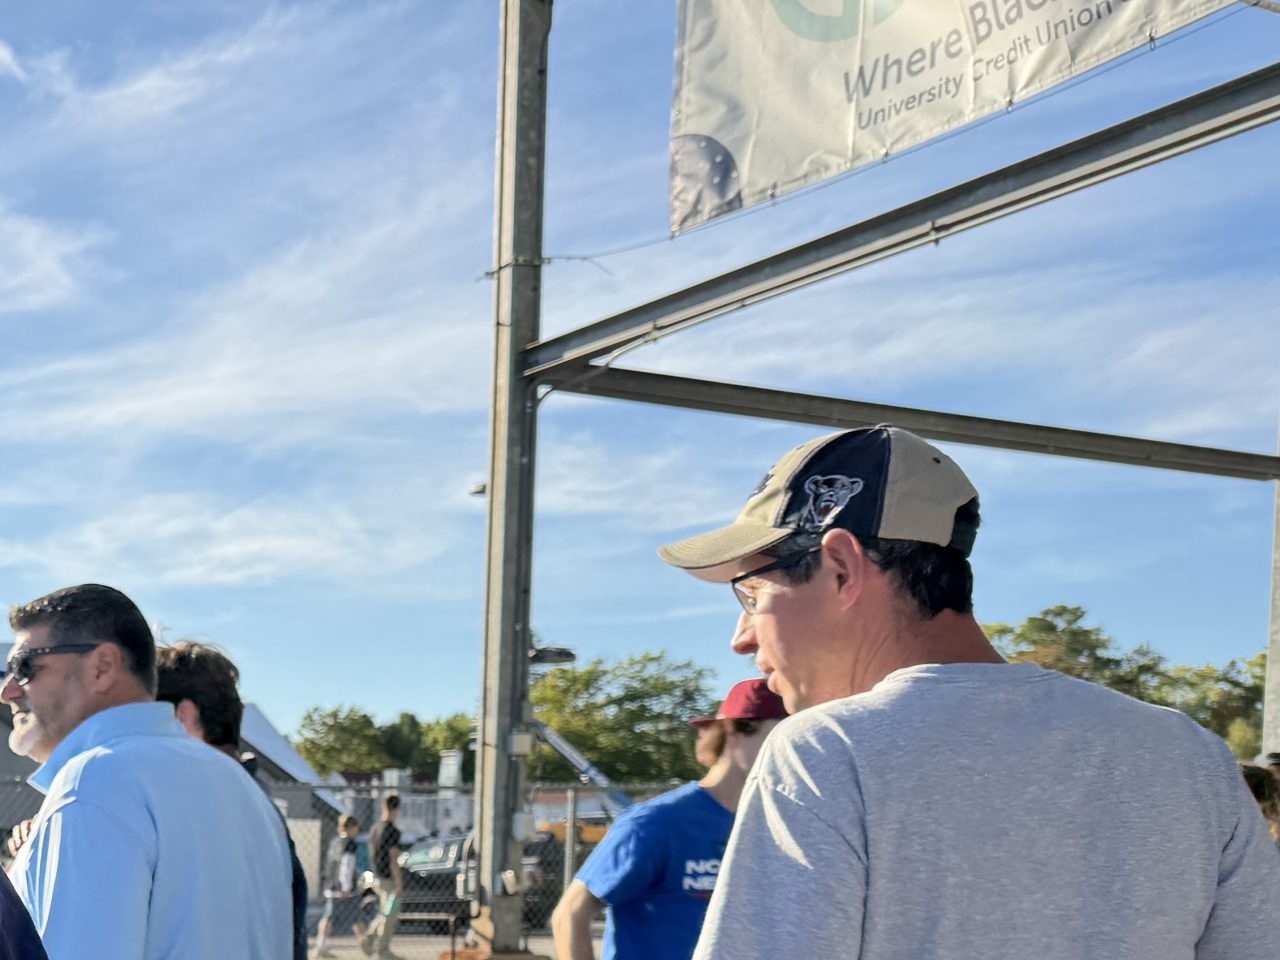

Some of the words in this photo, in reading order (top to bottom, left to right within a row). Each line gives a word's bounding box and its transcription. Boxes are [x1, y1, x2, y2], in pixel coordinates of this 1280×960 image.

[843, 28, 964, 105] Where
[858, 73, 964, 130] University
[971, 35, 1033, 82] Credit
[1035, 0, 1113, 45] Union
